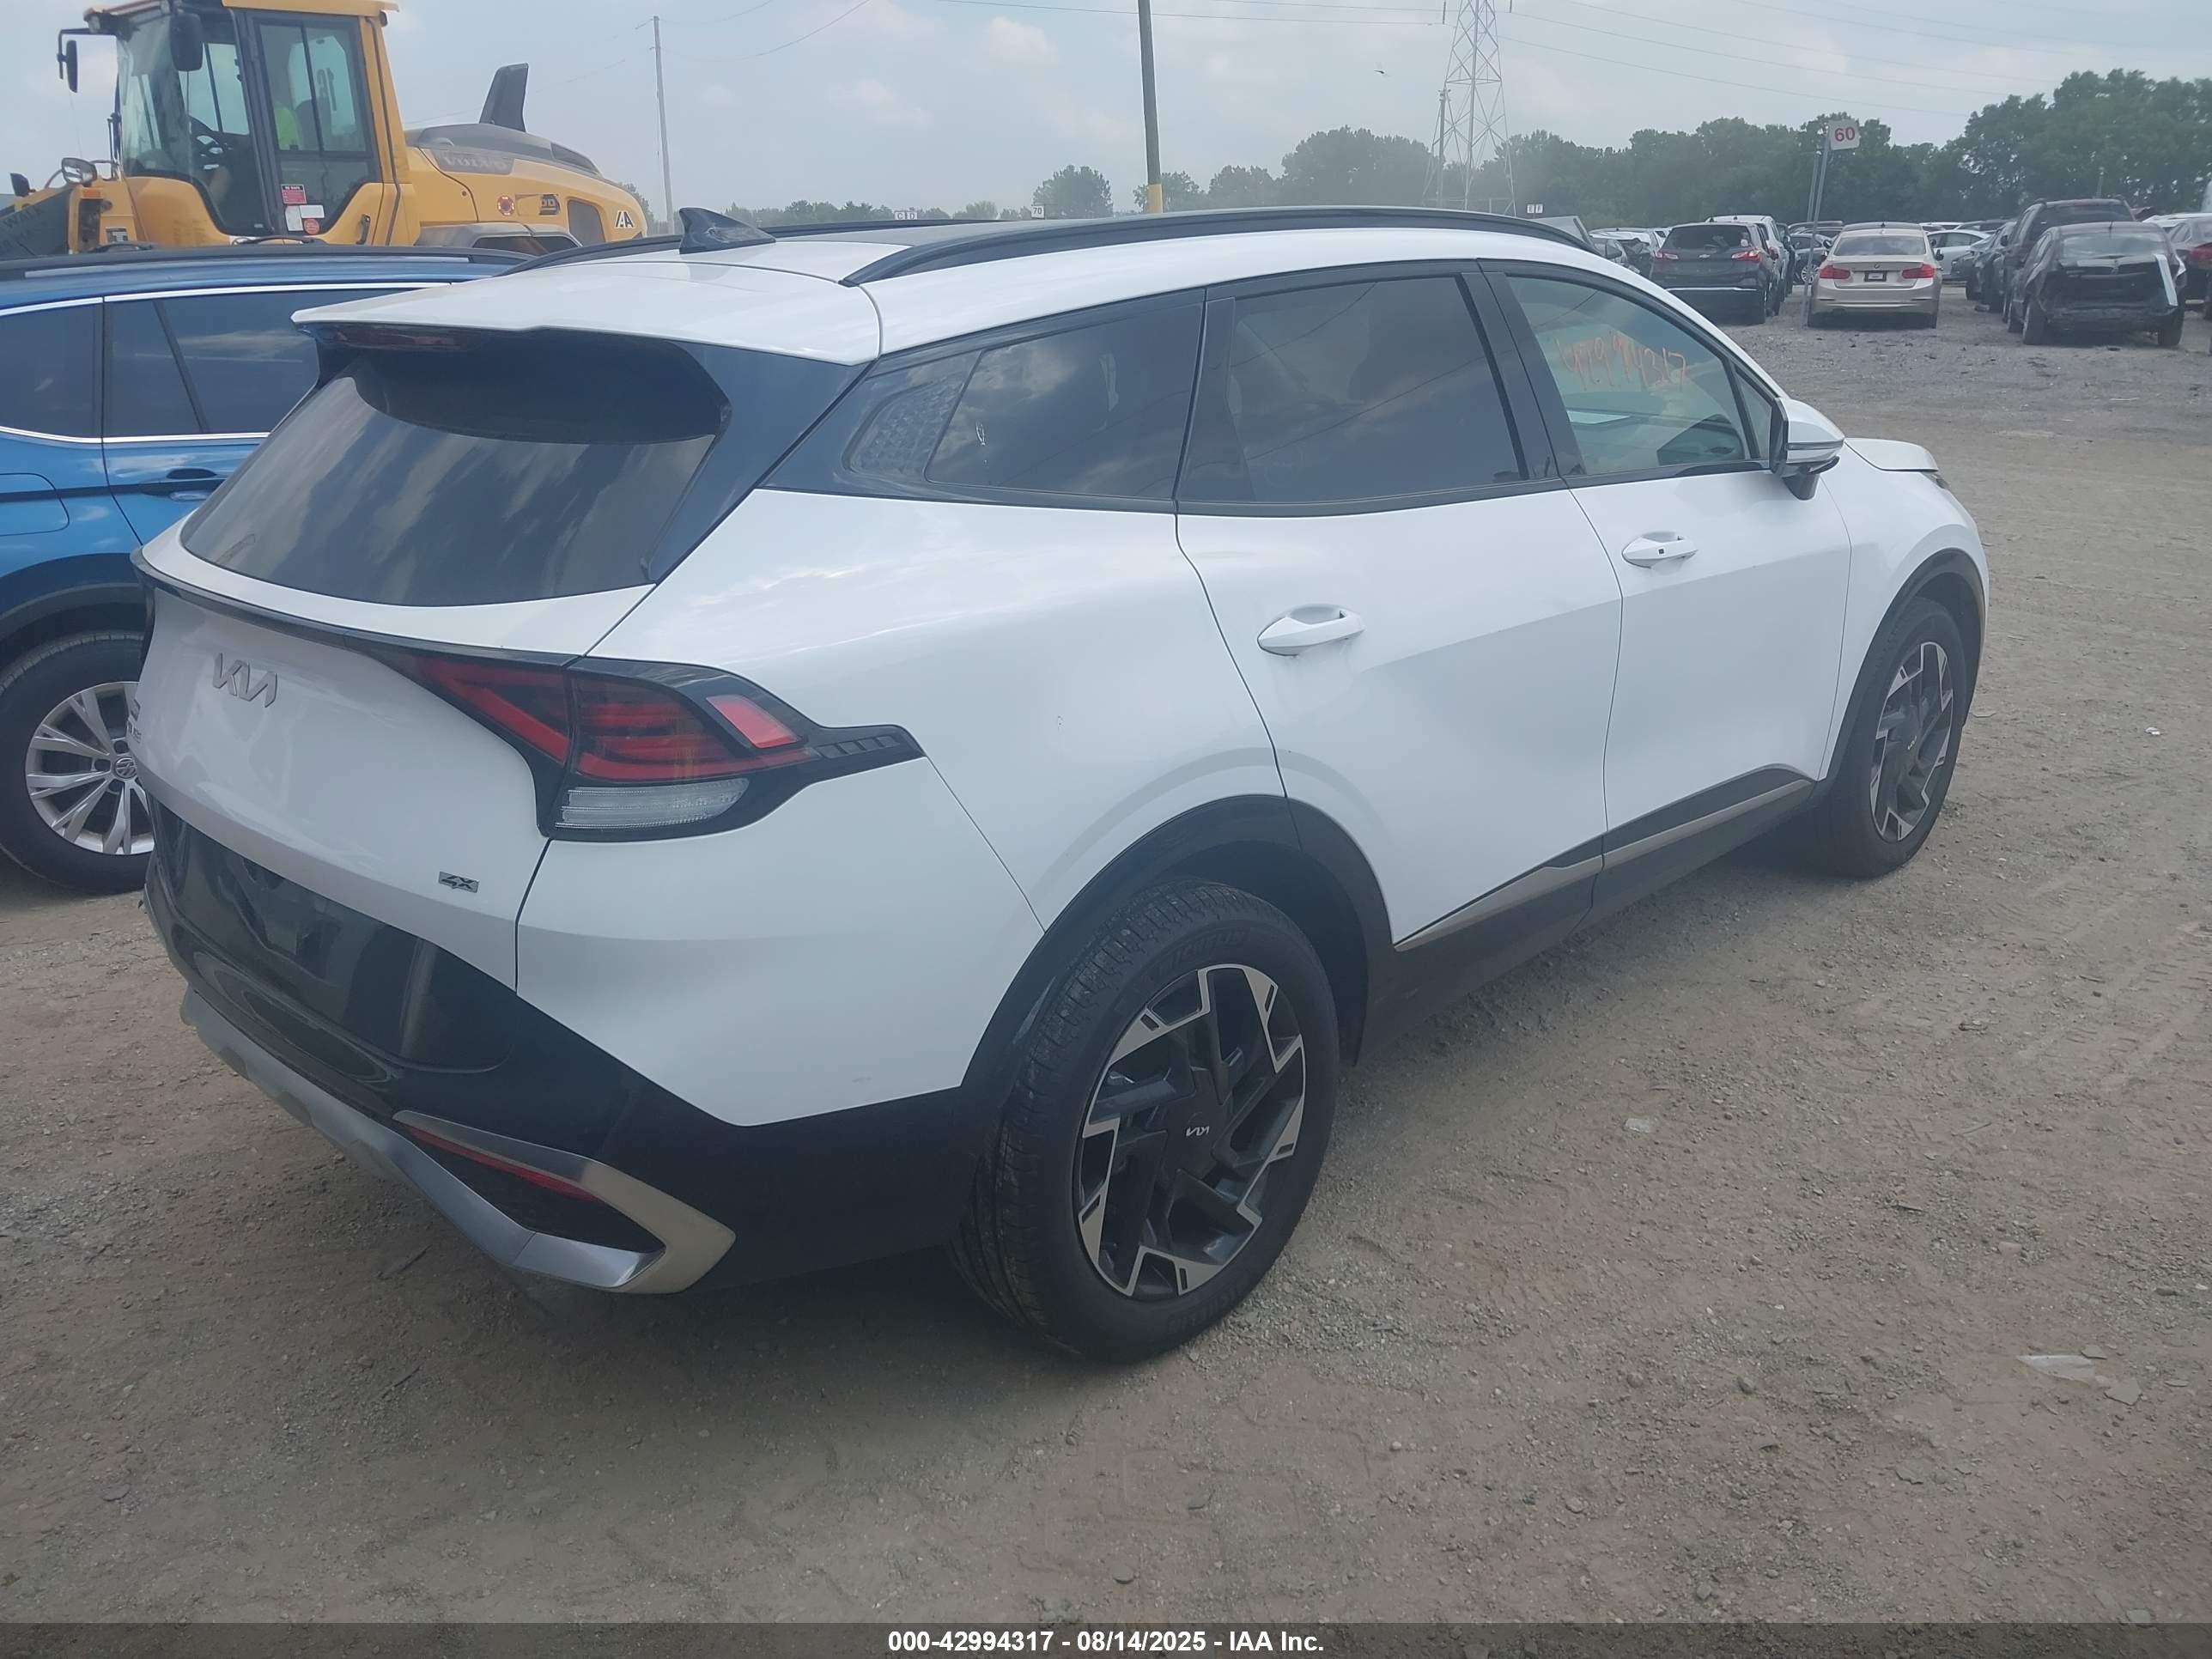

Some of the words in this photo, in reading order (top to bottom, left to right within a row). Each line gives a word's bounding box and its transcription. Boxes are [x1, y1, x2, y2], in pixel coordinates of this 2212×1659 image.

[1834, 126, 1855, 142] 60
[212, 653, 277, 708] KIA
[1185, 1126, 1210, 1137] KIA
